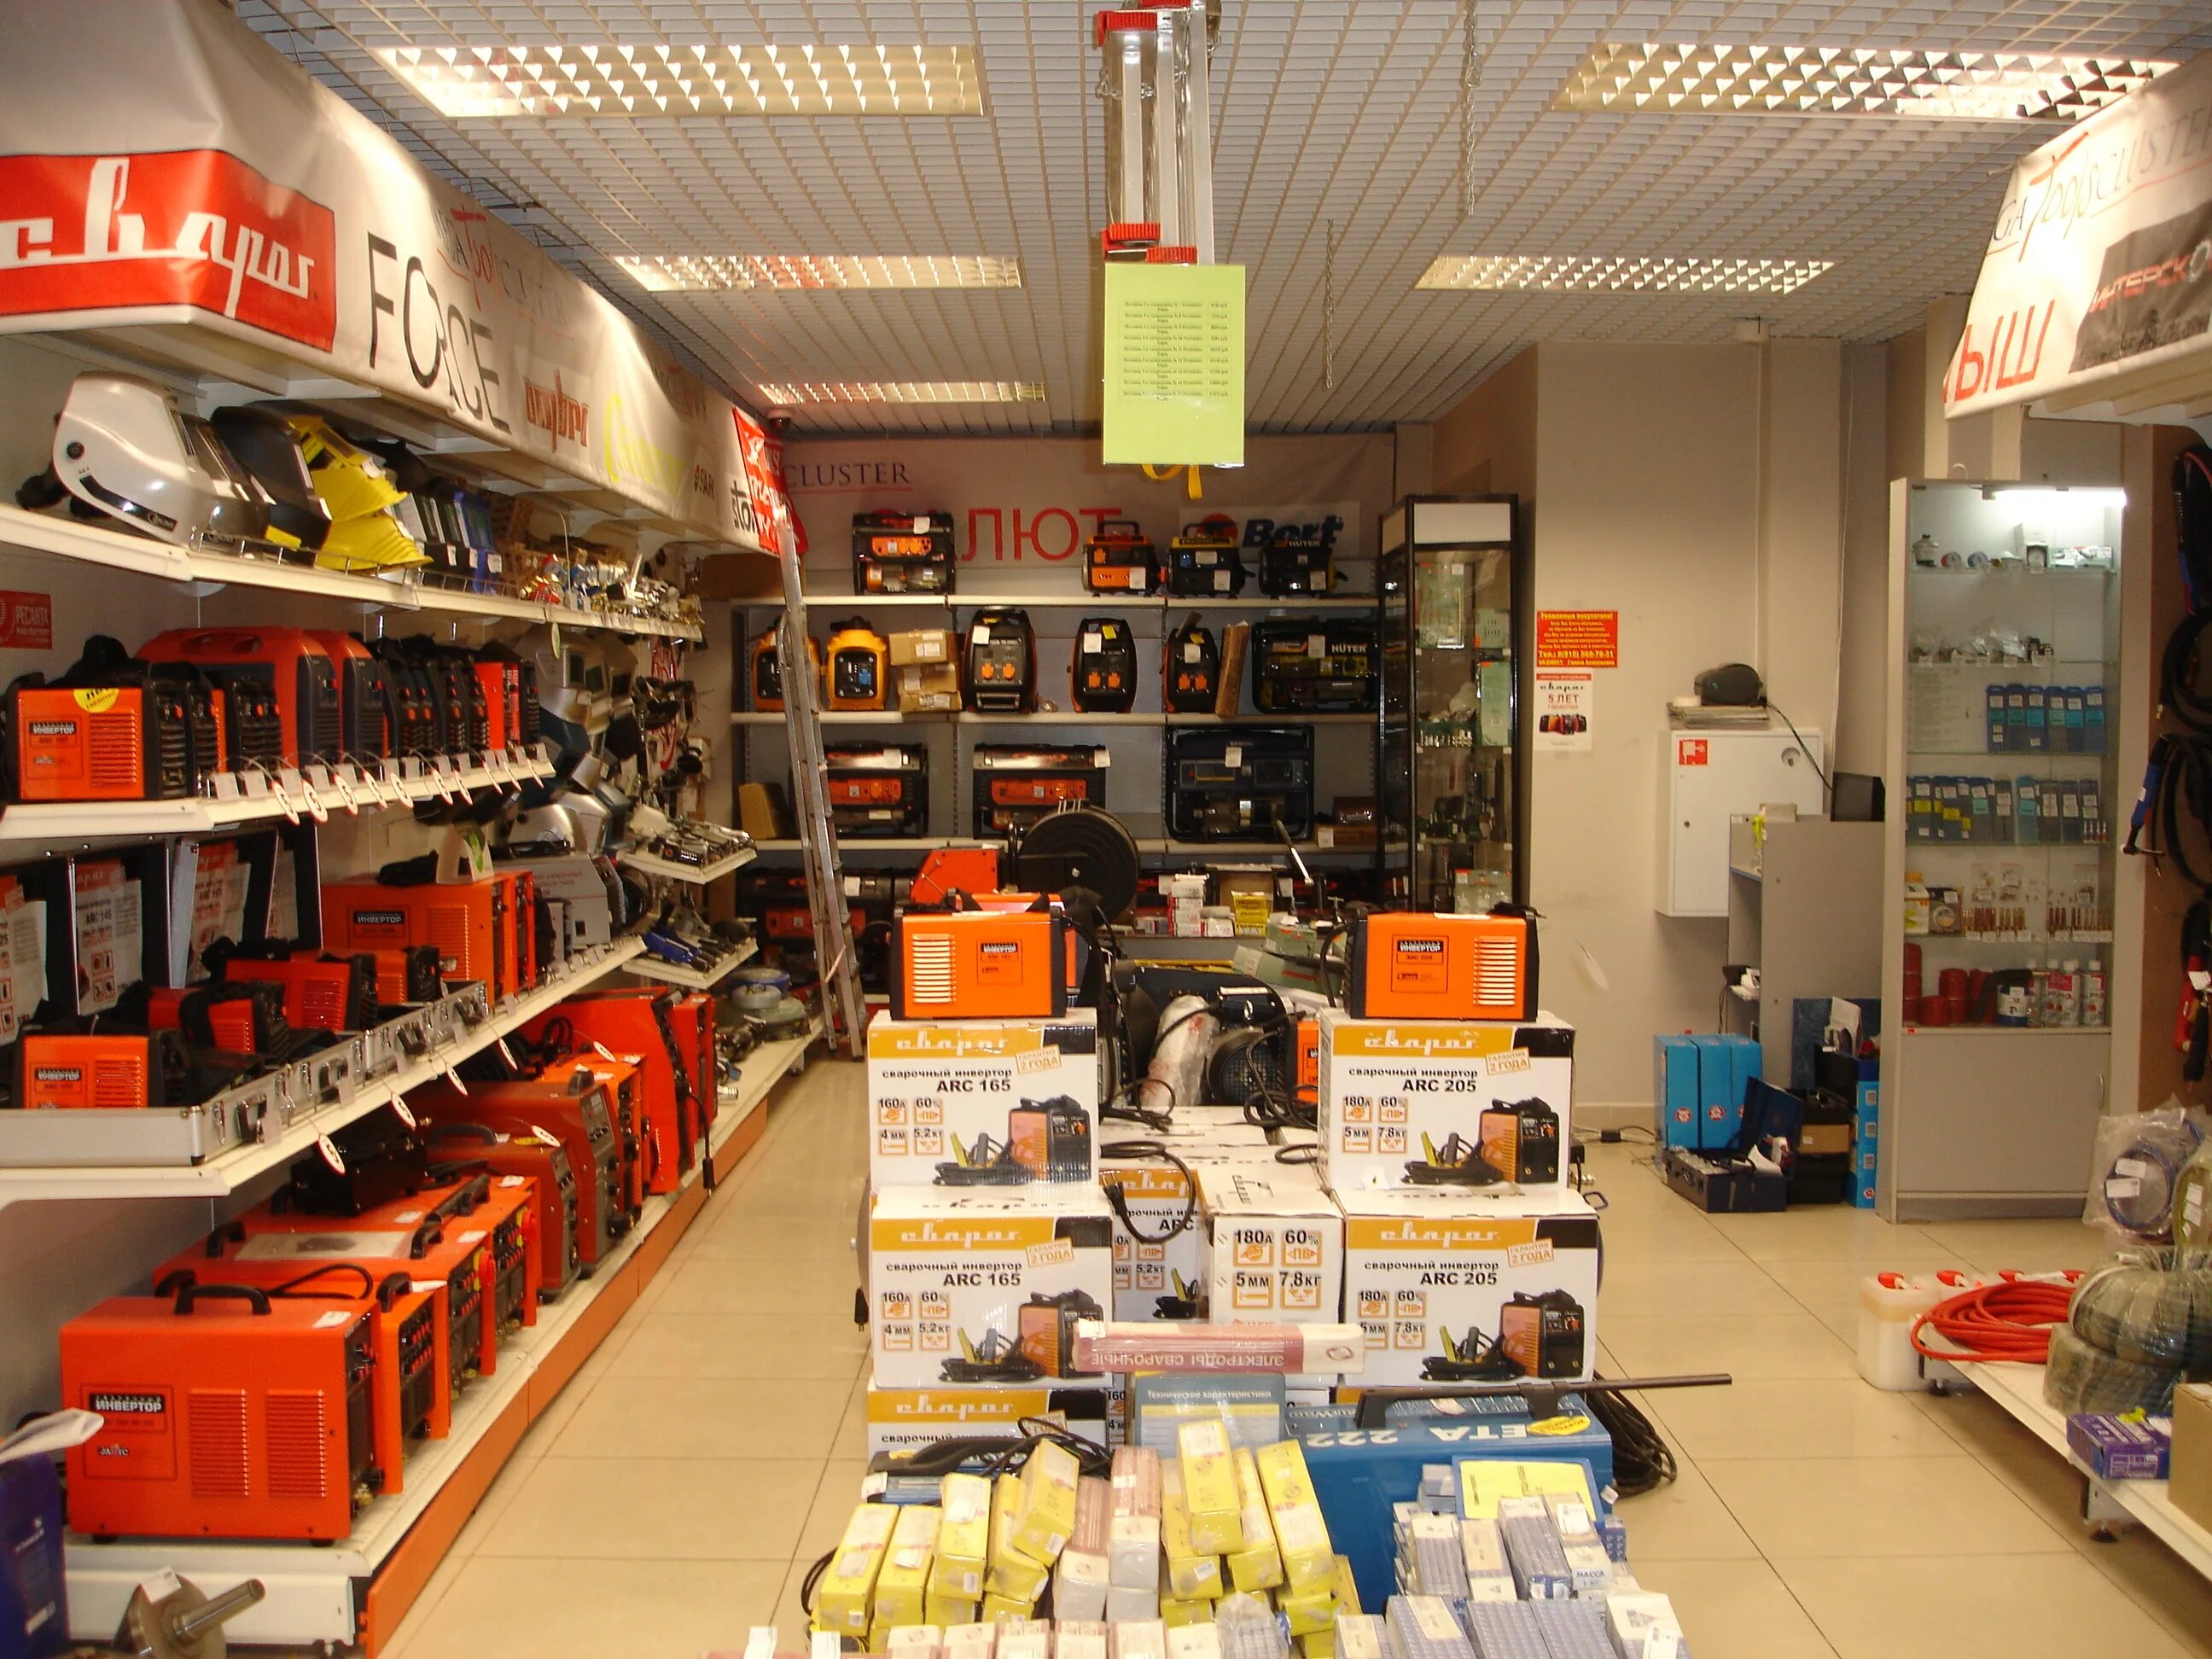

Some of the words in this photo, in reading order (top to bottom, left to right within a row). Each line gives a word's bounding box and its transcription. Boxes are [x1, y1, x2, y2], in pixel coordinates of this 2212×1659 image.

[1942, 300, 2055, 404] ЫШ
[785, 463, 910, 487] CLUSTER
[1557, 694, 1579, 703] ЛЕТ
[1027, 1056, 1059, 1068] ГОДА
[1499, 1058, 1528, 1071] ГОДА
[882, 1068, 951, 1080] сварочный
[955, 1069, 1012, 1080] инвертор
[1348, 1068, 1417, 1078] сварочный
[1421, 1068, 1478, 1079] инвертор
[936, 1080, 974, 1093] ARC
[981, 1080, 1011, 1092] 165
[1402, 1079, 1440, 1092] ARC
[1445, 1079, 1477, 1092] 205
[901, 1221, 1020, 1249] сварог
[1284, 1230, 1318, 1245] 60%
[1381, 1221, 1499, 1249] сварог
[1039, 1250, 1071, 1263] ГОДА
[1520, 1251, 1552, 1263] ГОДА
[886, 1261, 958, 1272] сварочный
[962, 1262, 1022, 1272] инвертор
[1365, 1260, 1435, 1271] сварочный
[1440, 1261, 1499, 1272] инвертор
[943, 1273, 982, 1287] ARC
[988, 1272, 1022, 1286] 165
[1420, 1272, 1458, 1285] ARC
[1464, 1272, 1498, 1285] 205
[1091, 1352, 1185, 1366] СВАРОЧНЫЕ
[1191, 1352, 1284, 1367] ЭЛЕКТРОДЫ
[1148, 1389, 1202, 1400] Технические
[1203, 1390, 1272, 1401] характеристики
[95, 1400, 162, 1413] ИНВЕРТОР
[896, 1394, 1017, 1421] сварог
[1307, 1429, 1398, 1447] 222
[1429, 1423, 1528, 1441] ETA
[882, 1434, 953, 1444] сварочный
[1576, 1569, 1605, 1580] МАССА
